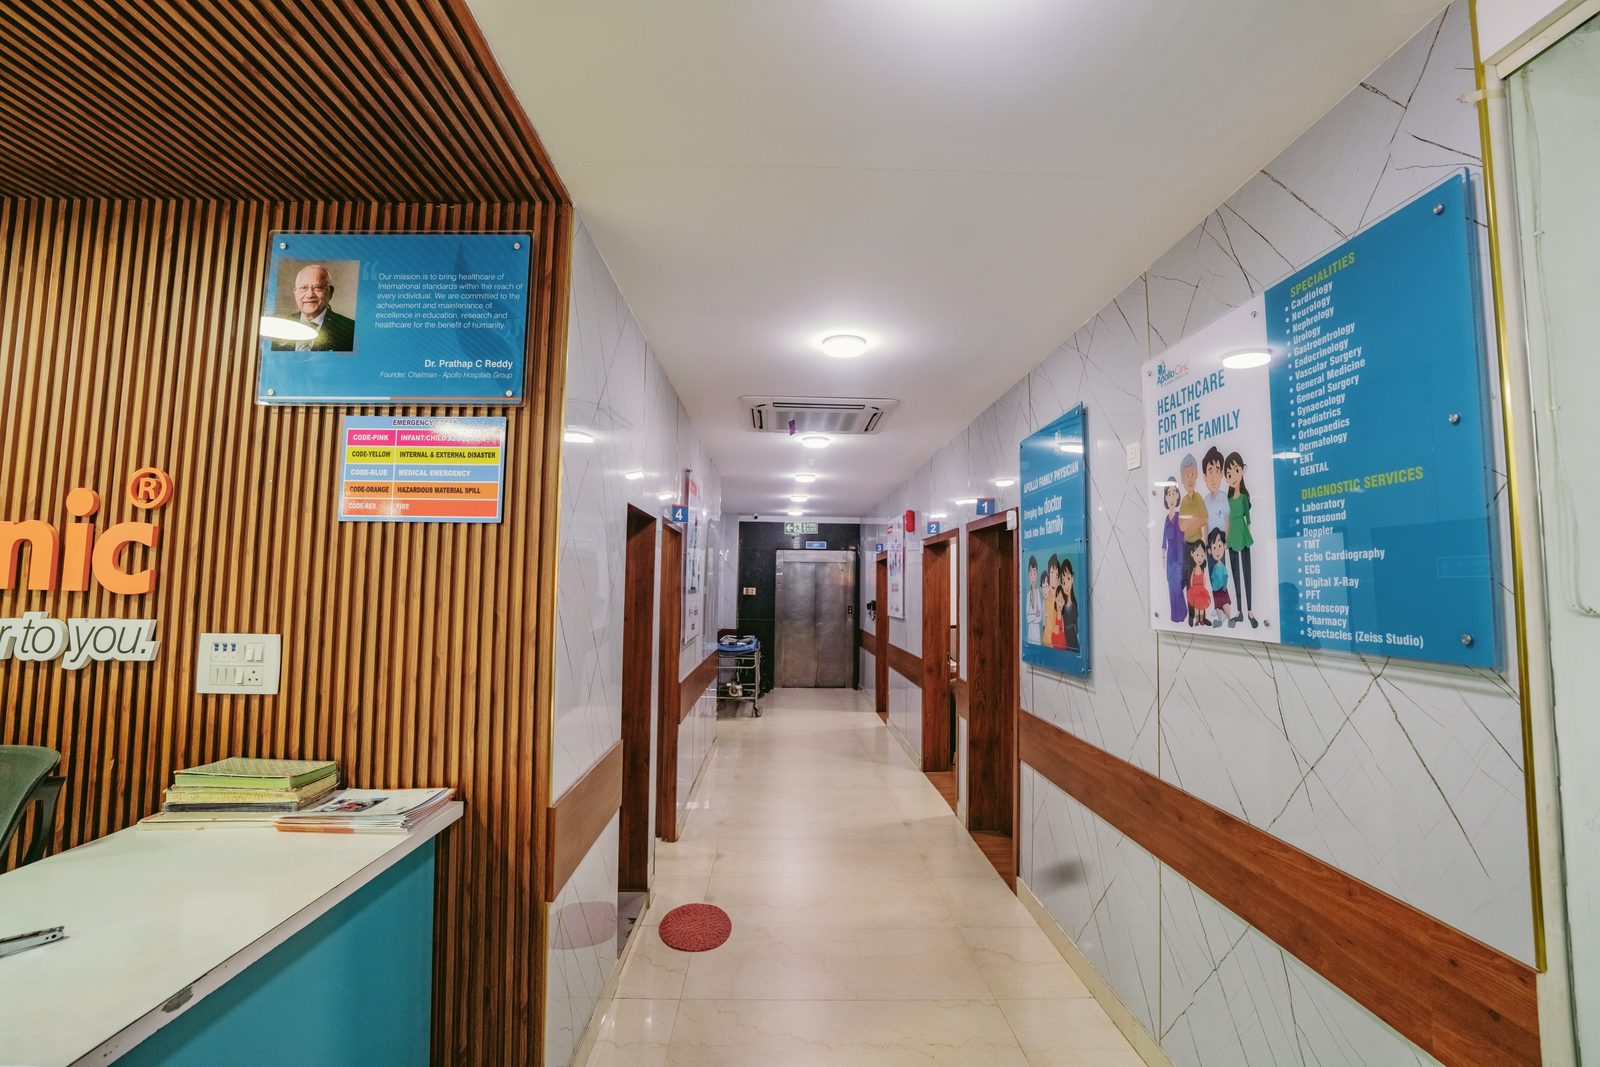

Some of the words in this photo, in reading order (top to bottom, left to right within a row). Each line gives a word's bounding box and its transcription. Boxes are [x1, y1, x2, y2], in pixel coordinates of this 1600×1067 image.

[379, 273, 392, 282] Our
[394, 273, 420, 282] mission
[422, 273, 429, 282] is
[430, 273, 437, 282] to
[438, 273, 457, 282] bring
[458, 273, 495, 282] healthcare
[497, 273, 505, 282] of
[1290, 252, 1356, 298] SPECIALITIES
[377, 292, 396, 300] every
[398, 292, 432, 300] individual.
[434, 292, 446, 300] We
[448, 292, 459, 300] are
[460, 292, 498, 300] committed
[500, 292, 508, 300] to
[509, 292, 520, 300] the
[1291, 281, 1333, 310] Cardiology
[1292, 294, 1331, 321] Neurology
[1292, 306, 1334, 333] Nephrology
[1293, 324, 1321, 345] Urology
[1294, 322, 1355, 356] Gastroentrology
[1294, 338, 1348, 368] Endocrinology
[1295, 360, 1327, 380] Vascular
[1330, 346, 1362, 367] Surgery
[424, 360, 436, 368] Dr.
[439, 360, 473, 369] Prathap
[475, 360, 482, 368] C
[484, 360, 513, 369] Reddy
[1296, 374, 1325, 392] General
[1327, 358, 1365, 380] Medicine
[1158, 369, 1225, 416] HEALTHCARE
[1296, 386, 1326, 404] General
[1327, 374, 1359, 394] Surgery
[1298, 393, 1345, 417] Gynaecology
[1158, 414, 1177, 435] FOR
[1180, 403, 1200, 426] THE
[1298, 407, 1341, 428] Paediatrics
[1160, 428, 1194, 455] ENTIRE
[1198, 408, 1240, 442] FAMILY
[1298, 418, 1350, 440] Orthopaedics
[1299, 432, 1347, 452] Dermatology
[1300, 452, 1314, 464] ENT
[1024, 478, 1038, 494] APOLLO
[1039, 472, 1053, 487] FAMILY
[1054, 460, 1078, 481] PHYSICIAN
[1300, 462, 1328, 476] DENTAL
[1301, 479, 1360, 500] DIAGNOSTIC
[1364, 466, 1424, 489] SERVICES
[675, 508, 683, 520] 4
[982, 502, 988, 513] 1
[1044, 495, 1062, 514] doctor
[1302, 499, 1345, 513] Laboratory
[1046, 515, 1063, 536] family
[1303, 510, 1346, 525] Ultrasound
[931, 524, 936, 533] 2
[1304, 526, 1334, 538] Doppler
[1304, 539, 1320, 549] TMT
[1304, 551, 1323, 561] Echo
[1325, 548, 1385, 561] Cardiography
[1305, 565, 1320, 574] ECG
[1305, 577, 1331, 588] Digital
[1334, 577, 1359, 588] X-Ray
[1306, 590, 1320, 600] PFT
[1306, 603, 1349, 615] Endoscopy
[1307, 616, 1347, 627] Pharmacy
[20, 619, 56, 654] to
[70, 626, 146, 662] you.
[1307, 628, 1352, 641] Spectacles
[1356, 631, 1383, 644] (Zeiss
[1386, 633, 1424, 649] Studio)
